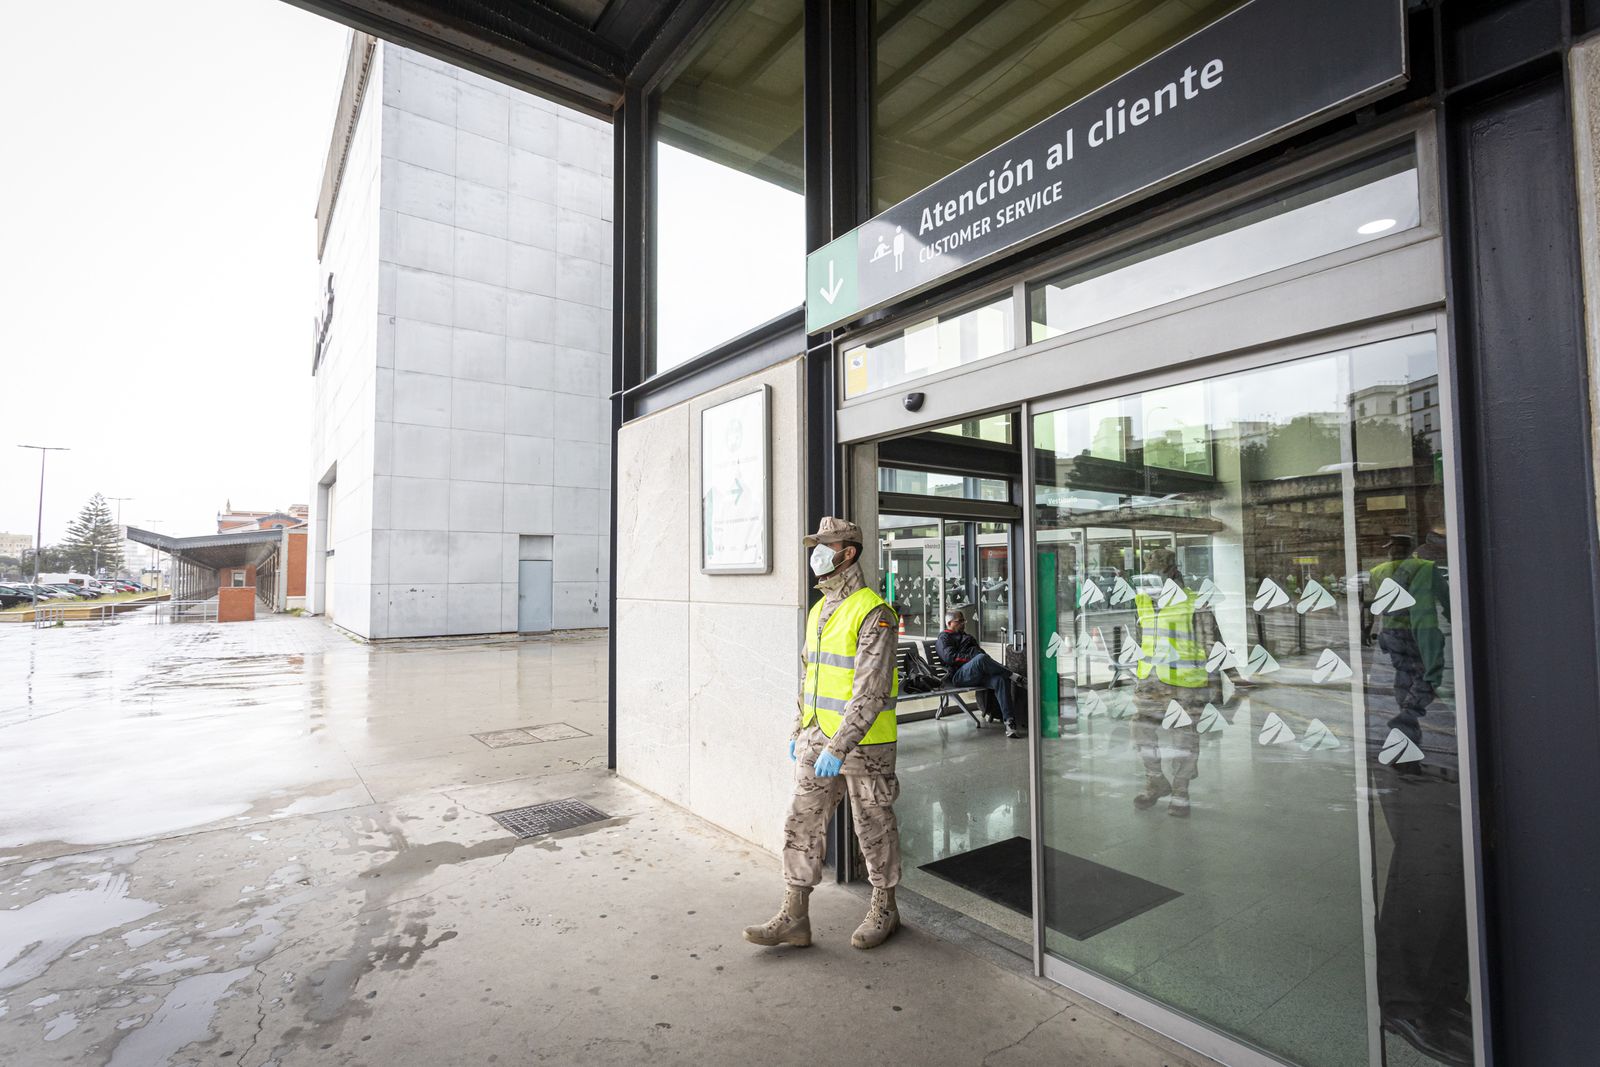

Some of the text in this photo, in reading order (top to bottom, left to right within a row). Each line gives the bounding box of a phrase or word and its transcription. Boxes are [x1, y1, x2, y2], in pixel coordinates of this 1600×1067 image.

[918, 58, 1224, 237] Atención al cliente
[919, 180, 1063, 263] CUSTOMER SERVICE
